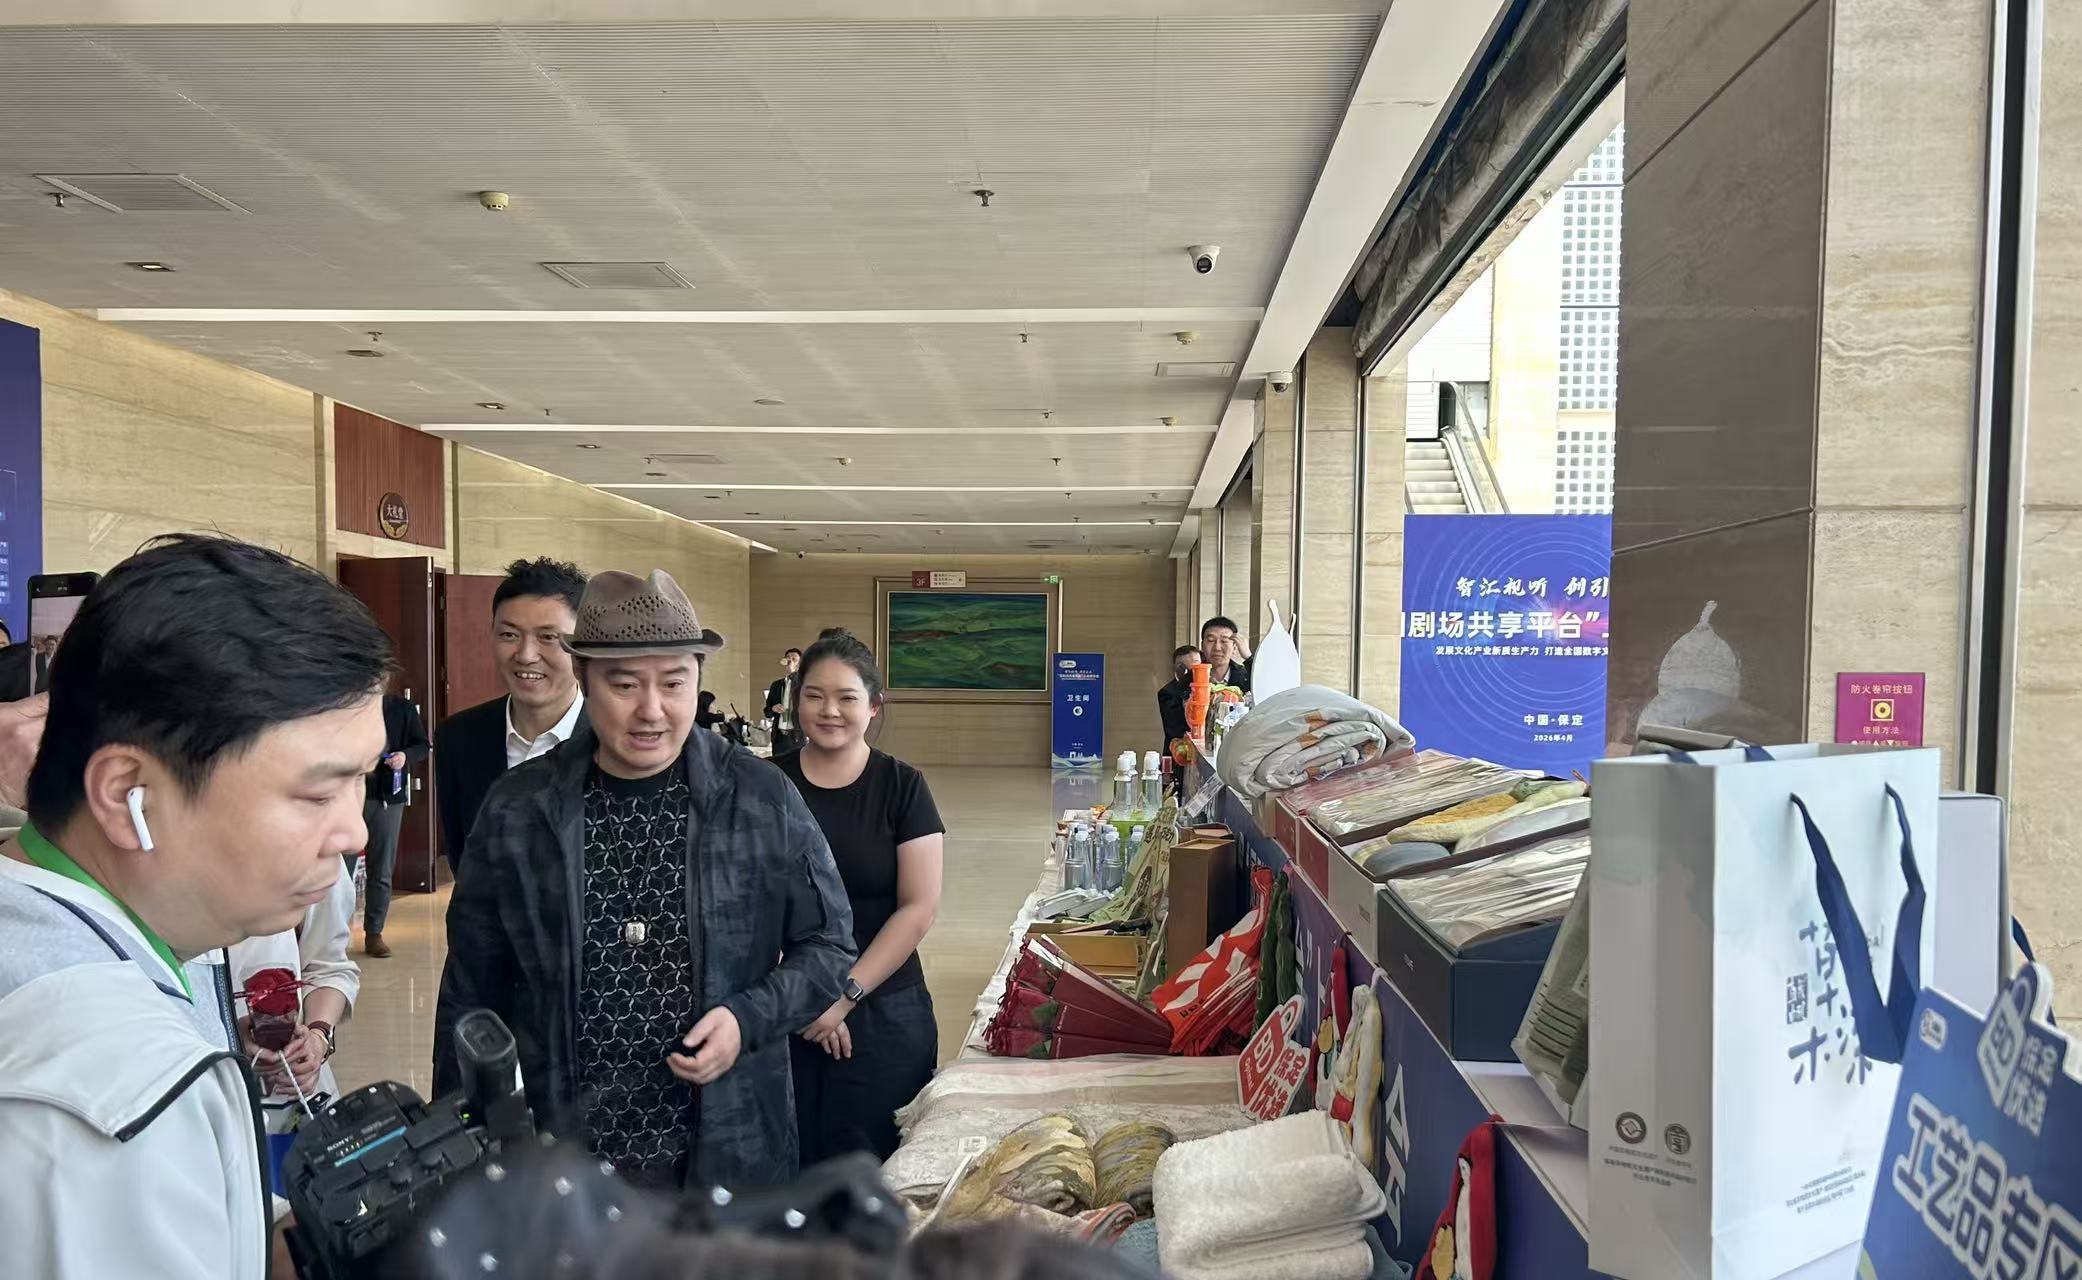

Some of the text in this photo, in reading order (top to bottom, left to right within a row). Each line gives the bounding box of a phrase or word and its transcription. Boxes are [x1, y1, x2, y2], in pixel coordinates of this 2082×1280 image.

[1456, 576, 1548, 598] 智汇视听
[1400, 611, 1610, 639] 剧场共享平台”
[1435, 646, 1539, 656] 发展文化产业新质生产力
[1850, 684, 1913, 694] 防火卷帘按钮
[1066, 694, 1090, 702] 卫生间
[1862, 726, 1900, 734] 使用方法
[1533, 734, 1573, 742] 2026年4月
[327, 1136, 349, 1152] SONY
